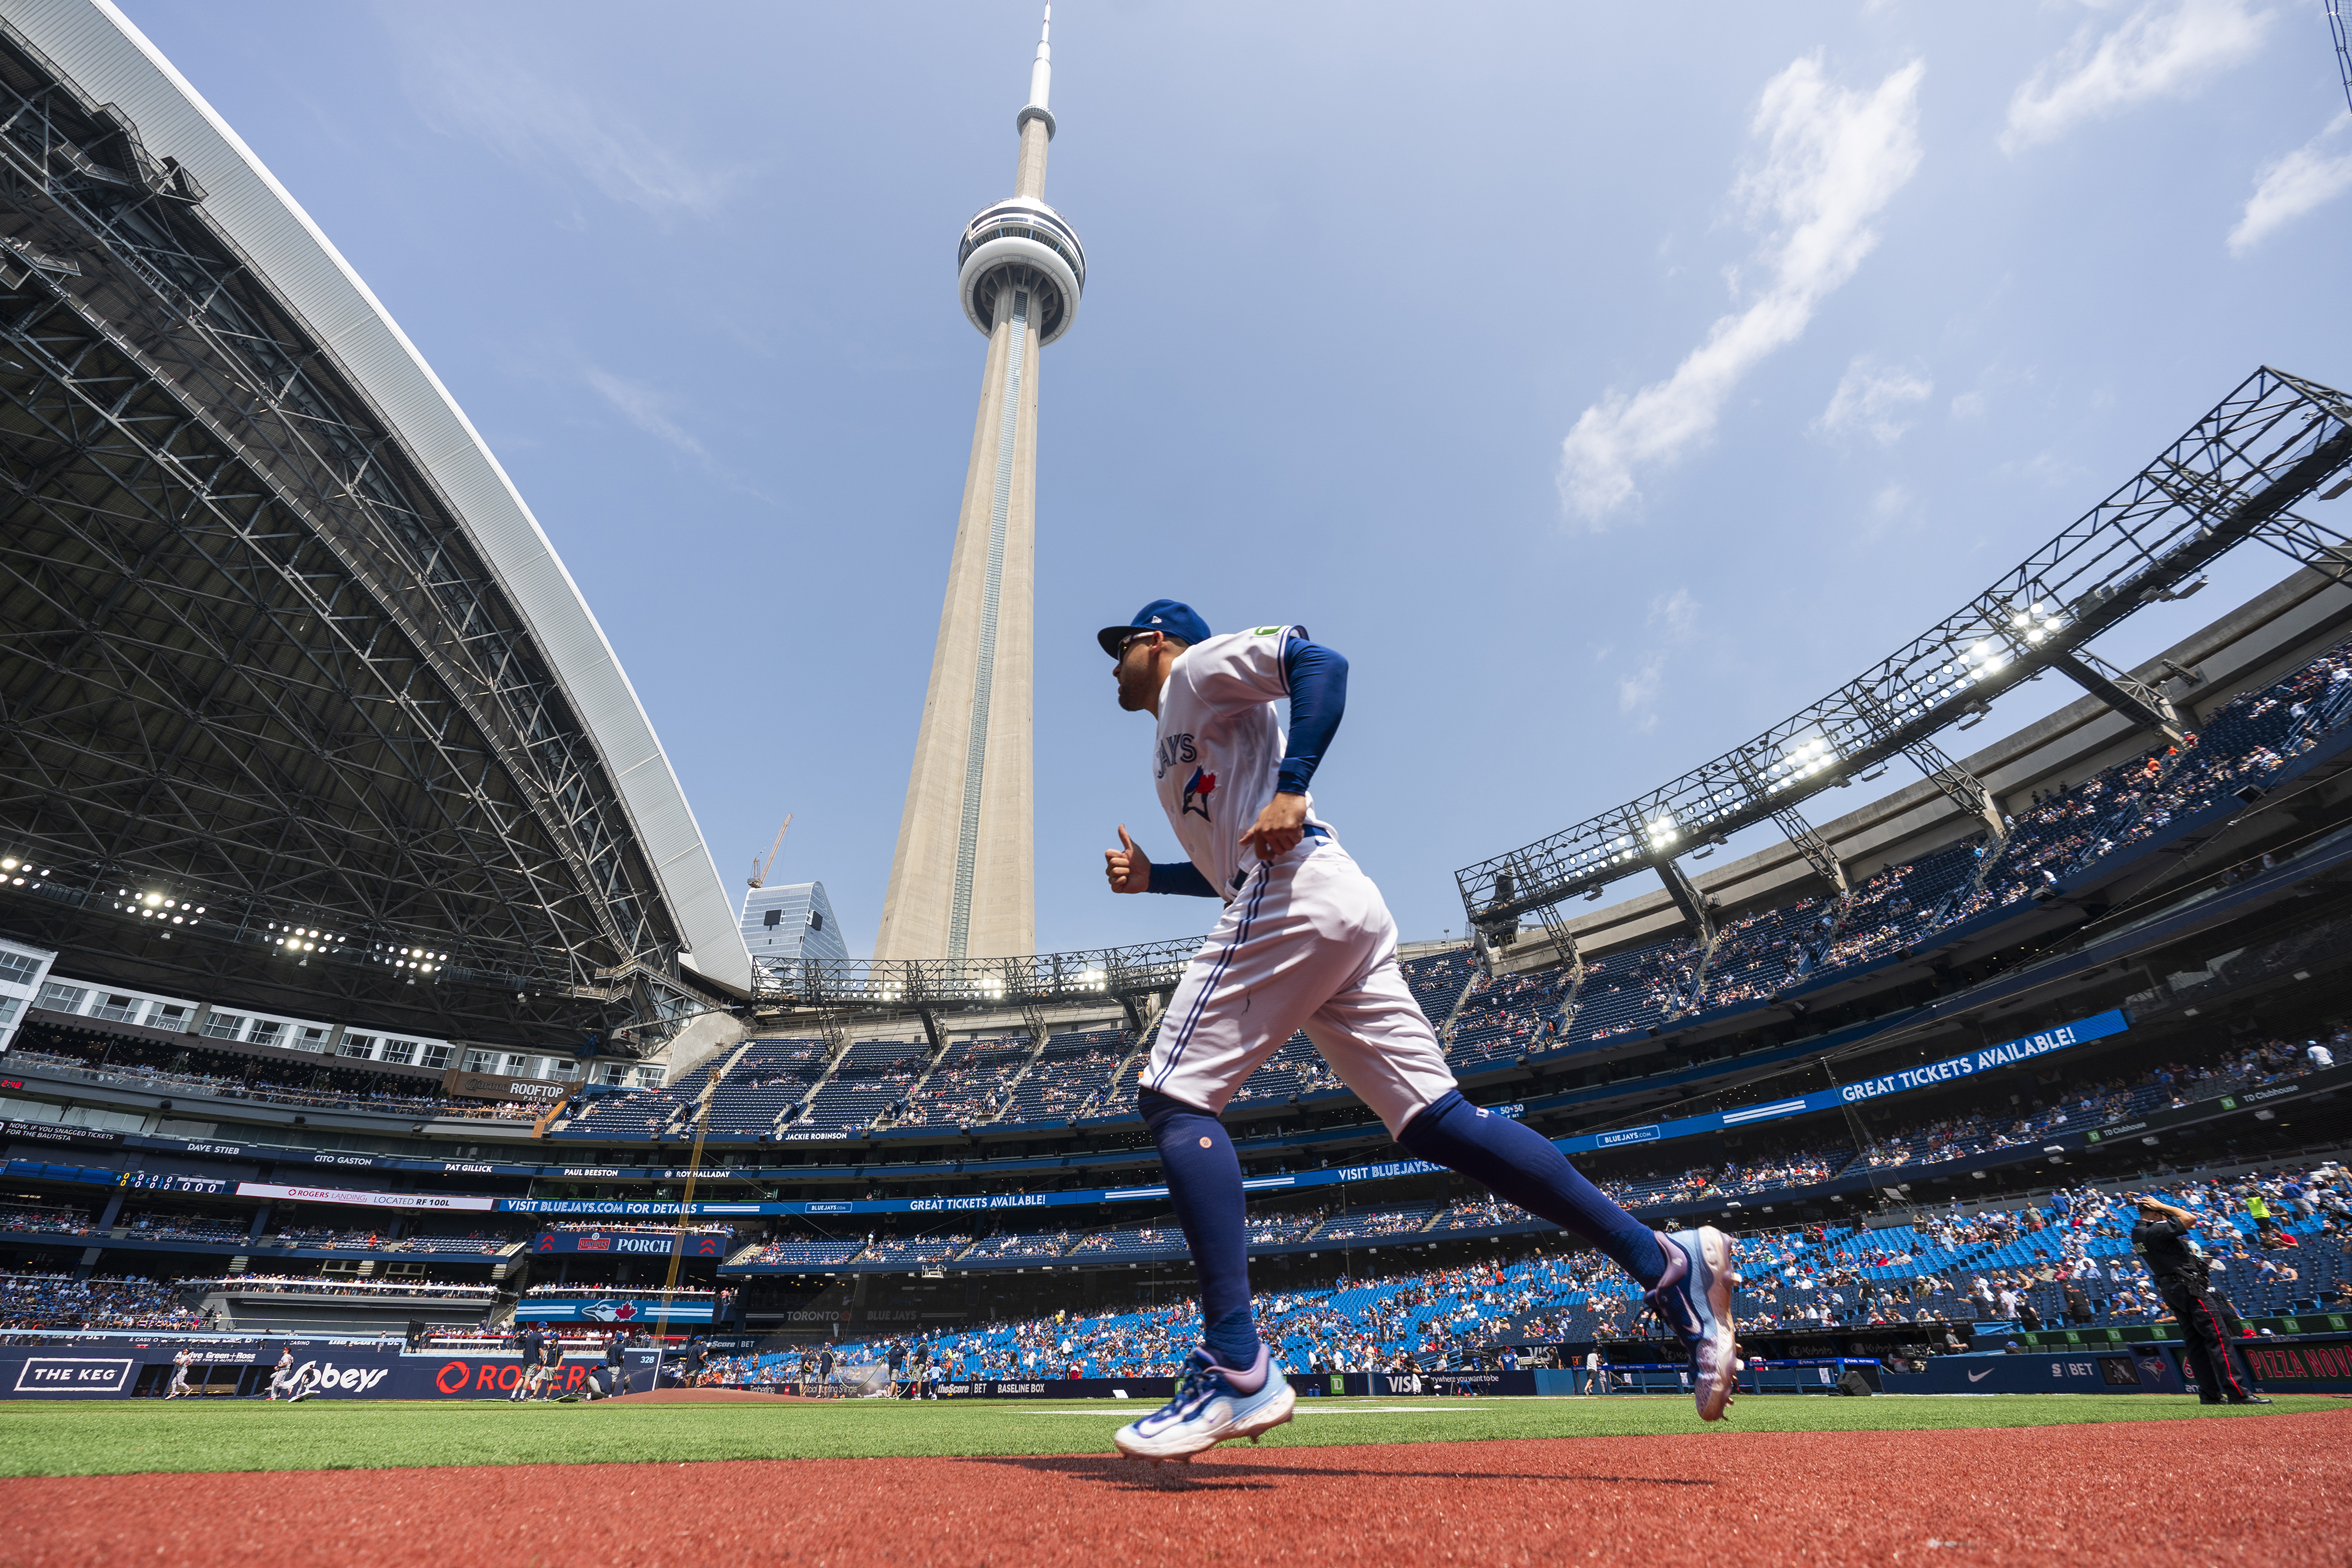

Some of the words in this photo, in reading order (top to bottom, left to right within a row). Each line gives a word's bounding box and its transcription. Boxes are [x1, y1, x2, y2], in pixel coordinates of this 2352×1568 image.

[1157, 733, 1197, 779] JAYS
[1842, 1076, 1895, 1101] GREAT
[1899, 1058, 1972, 1086] TICKETS
[1979, 1027, 2077, 1069] AVAILABLE!
[1, 1080, 22, 1088] 2:48
[510, 1082, 564, 1098] ROOFTOP
[2256, 1084, 2299, 1099] Clubhouse
[523, 1095, 547, 1103] PATIO
[54, 1127, 86, 1136] SNAGGED
[2113, 1121, 2147, 1134] Clubhouse
[36, 1132, 71, 1141] BAUTISTA
[1605, 1132, 1651, 1143] BLUEJAYS.COM
[187, 1144, 212, 1152] DAVE
[214, 1146, 240, 1155] STIEB
[337, 1156, 372, 1166] GASTON
[461, 1165, 493, 1173] GILLICK
[1338, 1168, 1368, 1181] VISIT
[1371, 1161, 1448, 1178] BLUEJAYS.C
[331, 1193, 367, 1202] LANDING
[373, 1196, 414, 1205] LOCATED
[910, 1199, 944, 1211] GREAT
[947, 1198, 987, 1209] TICKETS
[990, 1195, 1045, 1206] AVAILABLE!
[508, 1200, 538, 1211] VISIT
[540, 1202, 623, 1213] BLUEJAYS.COM
[626, 1204, 649, 1213] FOR
[652, 1203, 697, 1213] DETAILS
[616, 1239, 672, 1253] PORCH
[787, 1311, 840, 1320] TORONTO
[867, 1310, 891, 1320] BLUE
[892, 1310, 917, 1320] JAYS
[2068, 1363, 2093, 1376] BET
[2246, 1350, 2308, 1380] PIZZA
[35, 1369, 74, 1380] THE
[78, 1369, 116, 1380] KEG
[282, 1360, 389, 1393] Sobeys
[937, 1384, 969, 1393] theScore
[974, 1383, 987, 1393] BET
[998, 1384, 1029, 1393] BASELINE
[1031, 1383, 1044, 1393] BOX
[1332, 1378, 1343, 1390] TD
[1386, 1376, 1412, 1392] VIS
